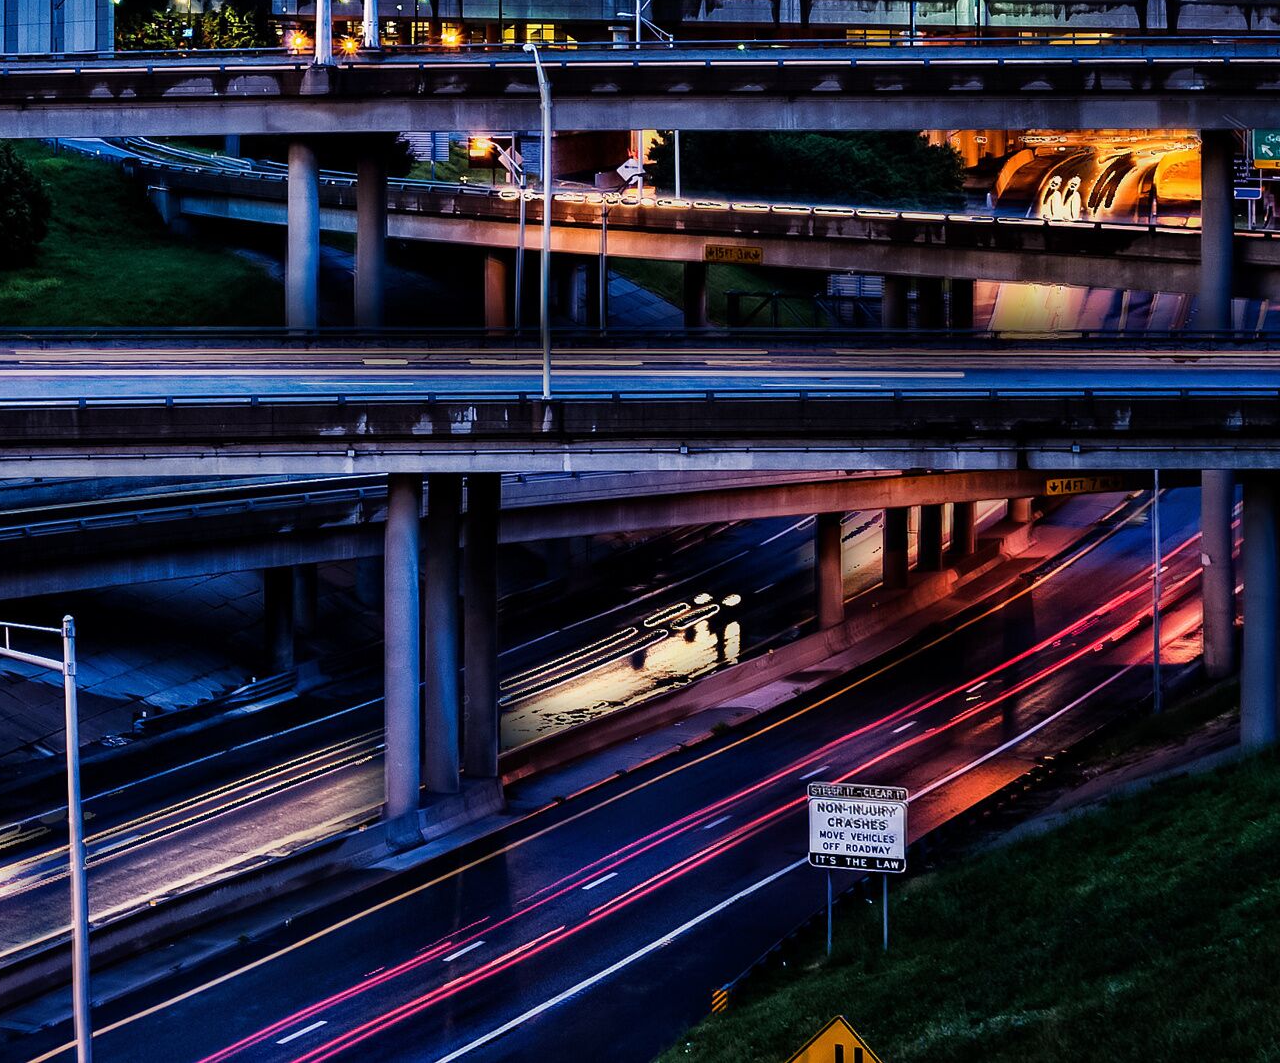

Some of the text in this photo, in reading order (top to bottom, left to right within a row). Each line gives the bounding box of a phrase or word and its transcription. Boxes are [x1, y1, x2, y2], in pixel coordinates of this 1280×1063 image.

[1061, 480, 1071, 492] 14
[1090, 479, 1098, 490] 7
[811, 787, 843, 796] STEER
[846, 787, 854, 796] IT
[864, 788, 893, 798] CLEAR
[896, 790, 905, 799] IT
[817, 803, 898, 817] NON-INJURY
[827, 817, 888, 831] CRASHES
[820, 830, 895, 843] MOVE VEHICLES
[822, 842, 891, 854] OFF ROADWAY
[815, 855, 899, 869] IT'S THE LAW
